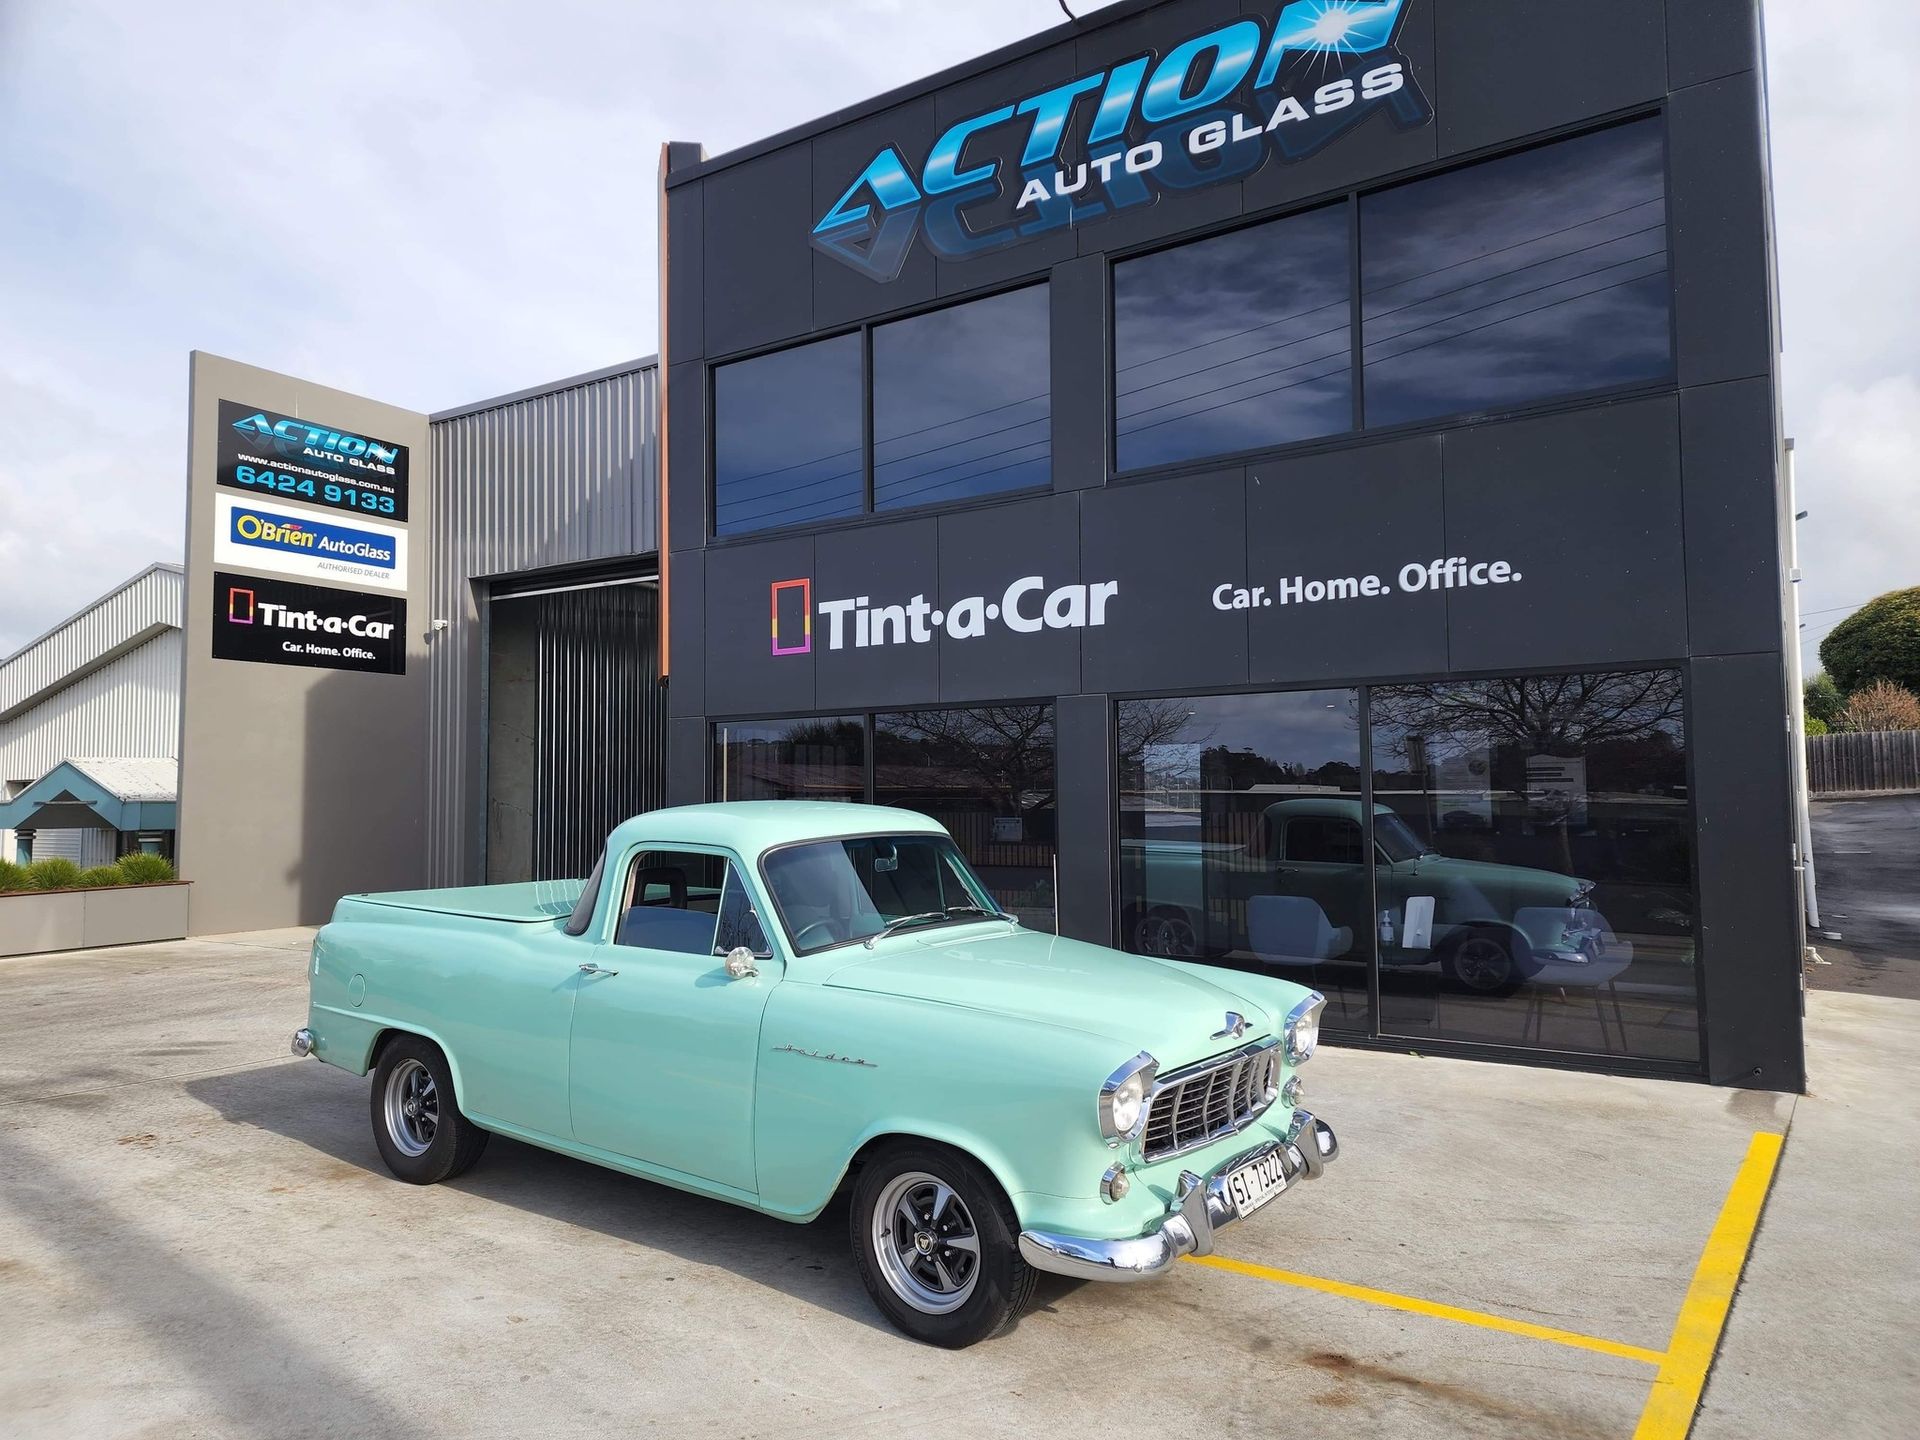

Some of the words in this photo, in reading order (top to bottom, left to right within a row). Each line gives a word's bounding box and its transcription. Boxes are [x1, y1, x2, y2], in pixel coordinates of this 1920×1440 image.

[811, 0, 1403, 234] ACTION
[1015, 140, 1163, 210] AUTO
[1188, 62, 1405, 155] GLASS
[232, 413, 399, 465] ACTION
[303, 446, 344, 463] AUTO
[349, 457, 396, 476] GLASS
[236, 465, 316, 498] 6424
[324, 484, 395, 514] 9133
[237, 452, 395, 494] www.actionautoglass.com.au
[237, 514, 314, 548] O'Brien
[317, 536, 391, 561] AutoGlass
[316, 561, 363, 576] AUTHORISED
[364, 568, 390, 580] DEALER
[1211, 583, 1272, 611] Car.
[1279, 575, 1391, 606] Home.
[1398, 556, 1523, 593] Office.
[282, 641, 304, 653] Car.
[306, 643, 341, 657] Home.
[342, 647, 376, 660] Office.
